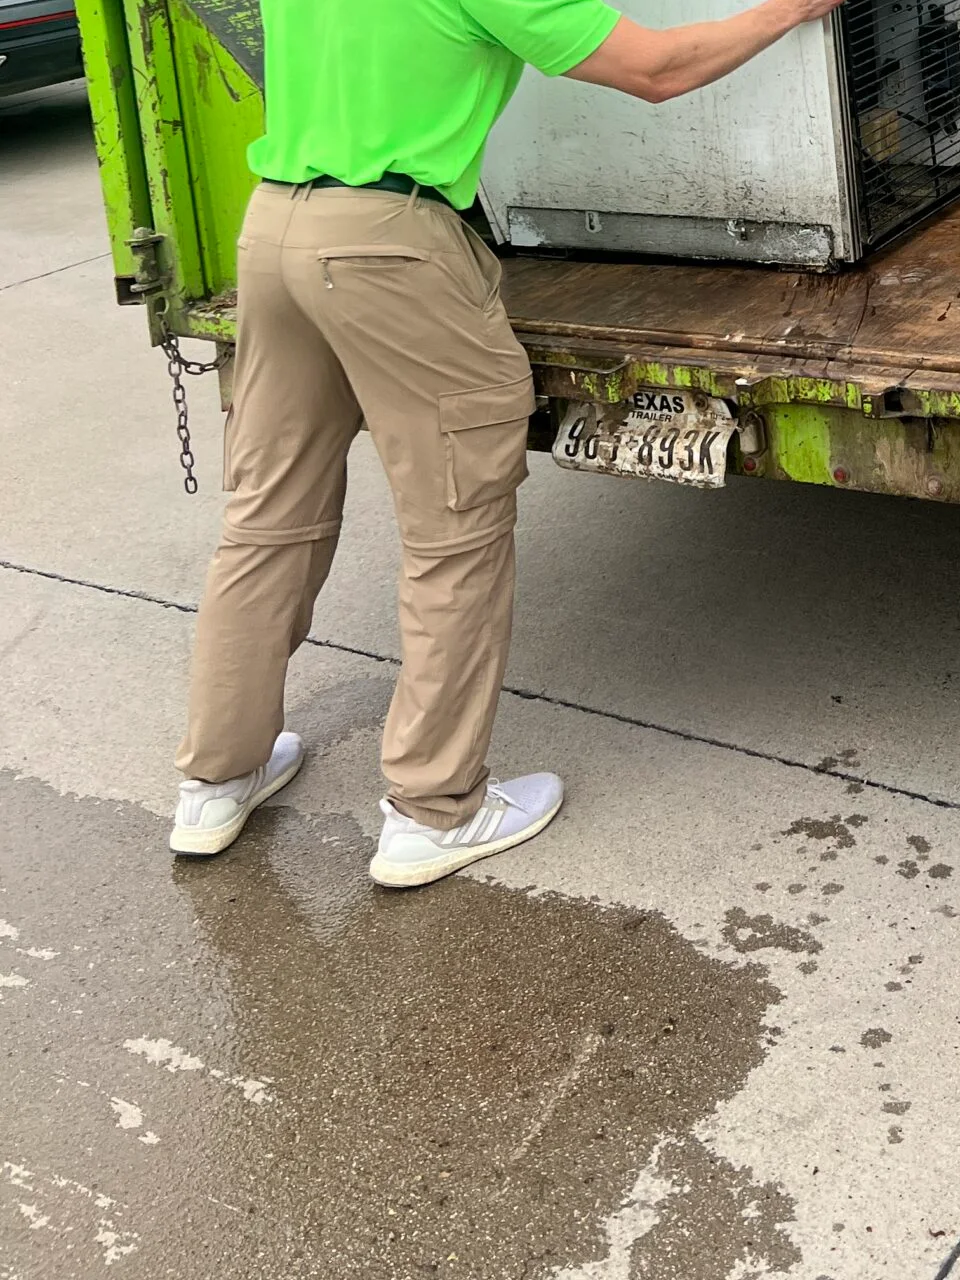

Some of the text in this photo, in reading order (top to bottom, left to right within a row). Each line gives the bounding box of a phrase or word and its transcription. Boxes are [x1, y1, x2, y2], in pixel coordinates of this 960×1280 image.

[630, 392, 685, 414] EXAS
[631, 410, 672, 423] TRAILER
[637, 424, 721, 475] 893K
